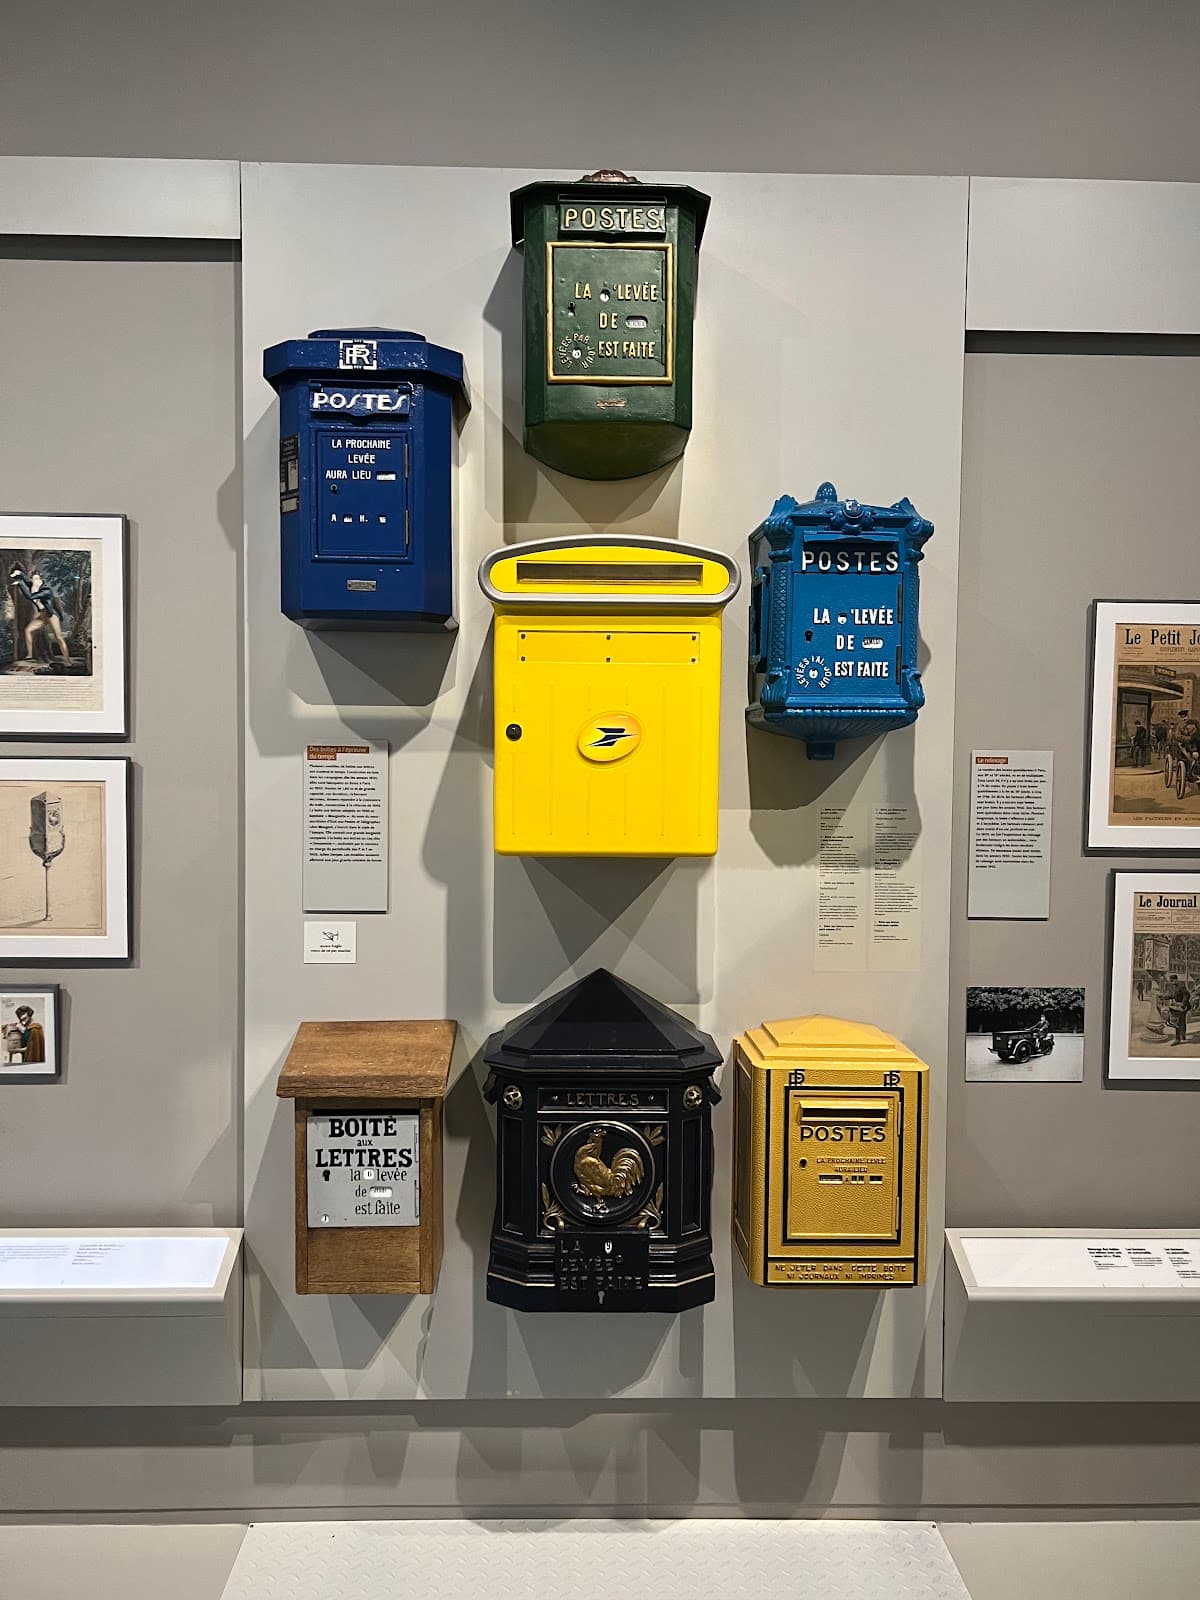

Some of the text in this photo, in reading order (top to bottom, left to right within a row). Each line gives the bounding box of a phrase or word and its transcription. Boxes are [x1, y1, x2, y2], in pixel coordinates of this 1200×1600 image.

[564, 207, 661, 230] POSTES
[575, 283, 592, 299] LA
[599, 312, 618, 329] DE
[598, 341, 619, 358] EST
[623, 341, 656, 359] FAITE
[312, 391, 409, 411] POSTES
[331, 439, 391, 450] LA PROCHAINE
[348, 453, 376, 464] LEVÉE
[325, 470, 348, 480] AURA
[352, 470, 372, 480] LIEU
[801, 551, 899, 572] POSTES
[813, 608, 831, 624] LA
[836, 634, 855, 650] DE
[1125, 628, 1141, 645] Le
[1150, 628, 1181, 646] Petit
[835, 662, 889, 677] EST FAITE
[1139, 895, 1197, 908] Le Journal
[567, 1093, 639, 1106] LETTRES
[800, 1126, 886, 1143] POSTES
[357, 1139, 373, 1147] aux
[315, 1148, 412, 1168] LETTRES
[350, 1168, 361, 1182] la
[376, 1167, 407, 1182] levée
[355, 1184, 367, 1198] de
[355, 1200, 401, 1215] est faite
[775, 1264, 786, 1272] NE
[790, 1264, 817, 1272] JETER
